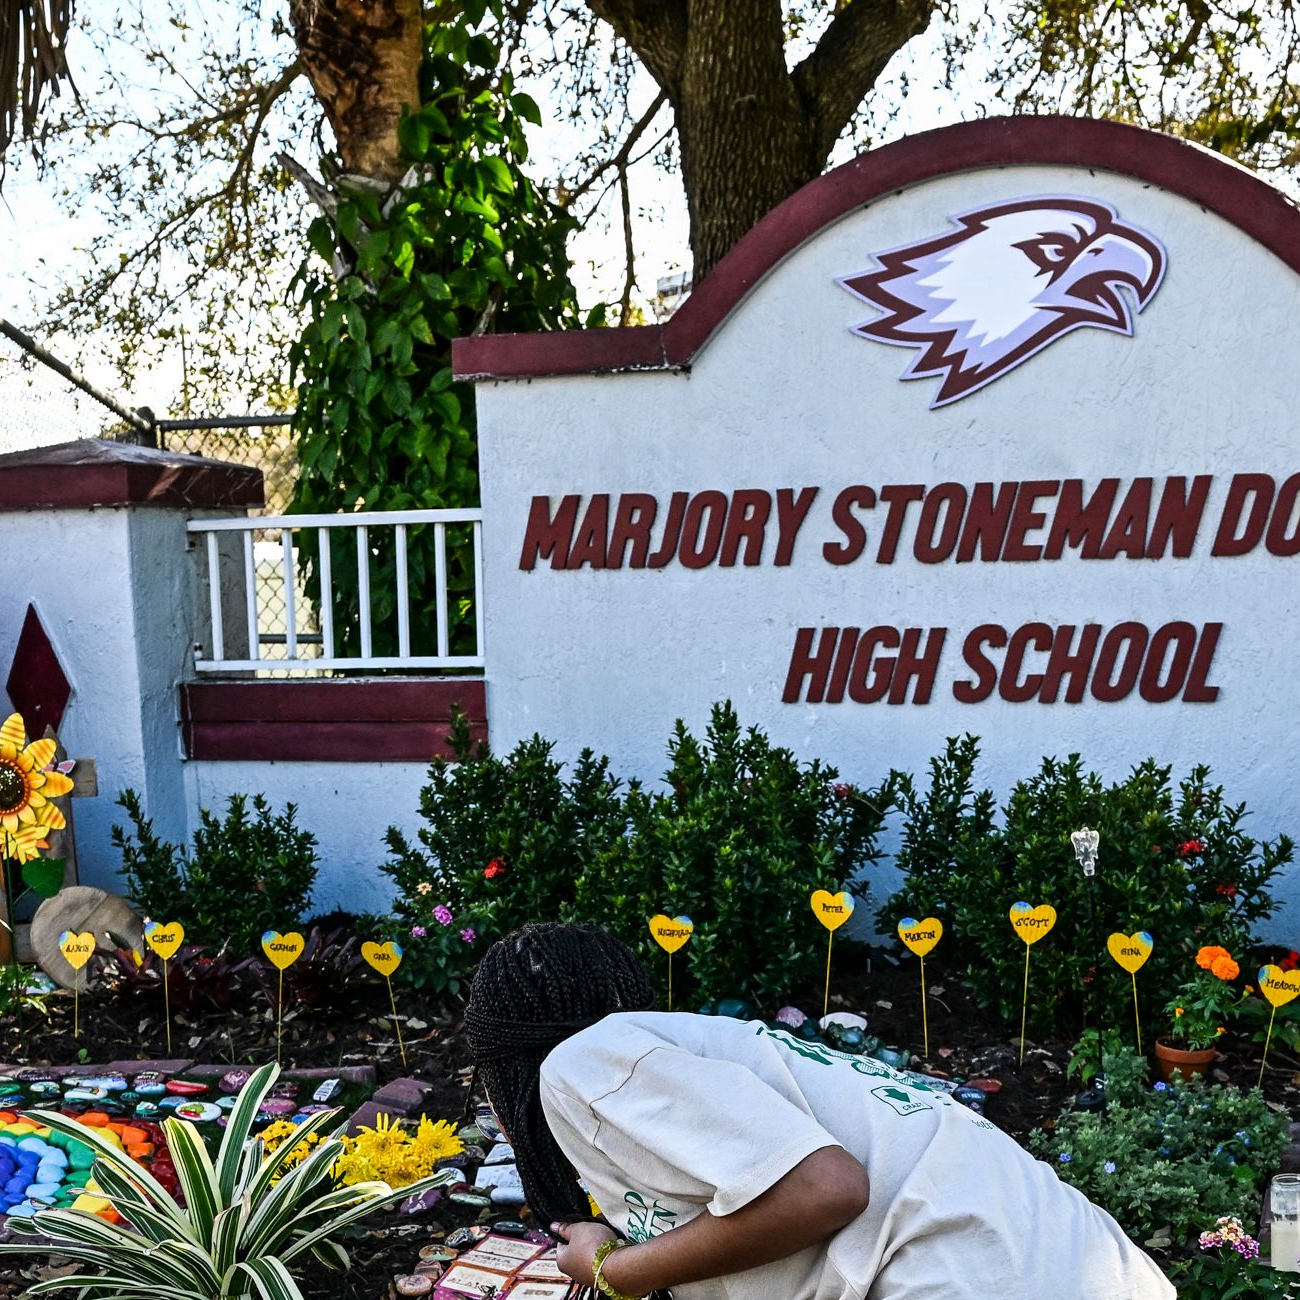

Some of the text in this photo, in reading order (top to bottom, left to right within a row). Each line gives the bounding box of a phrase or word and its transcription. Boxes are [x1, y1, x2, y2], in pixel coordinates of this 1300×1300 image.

[520, 487, 818, 570] MARJORY
[823, 474, 1212, 565] STONEMAN
[783, 620, 1224, 704] HIGH SCHOOL
[822, 903, 844, 914] PETER
[1015, 916, 1049, 928] SCOTT
[152, 933, 176, 943] CHRIS
[904, 930, 936, 942] MARTIN
[1266, 979, 1300, 992] MEADOW
